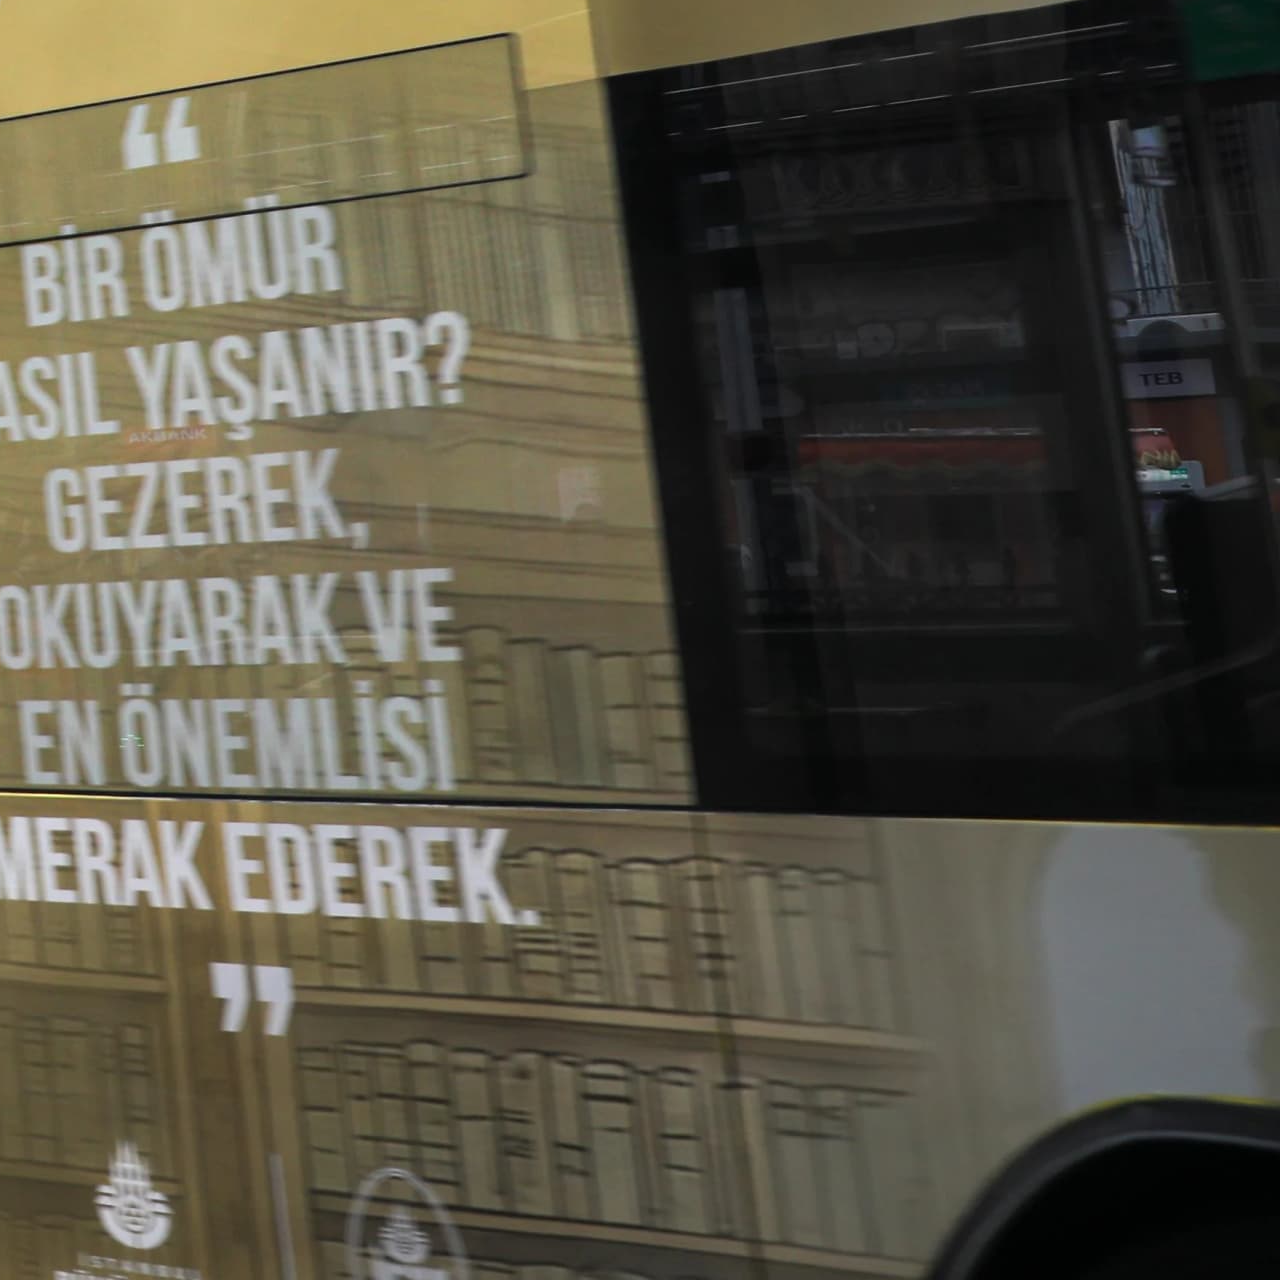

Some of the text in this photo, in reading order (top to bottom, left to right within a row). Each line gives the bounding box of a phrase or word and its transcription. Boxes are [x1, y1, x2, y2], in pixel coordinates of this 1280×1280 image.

[21, 194, 342, 328] BİR ÖMÜR
[126, 311, 471, 442] YAŞANIR?
[1140, 371, 1184, 387] TEB
[44, 448, 370, 554] GEZEREK,
[356, 567, 463, 663] VE
[18, 679, 457, 791] EN ÖNEMLİSİ
[221, 821, 541, 926] EDEREK.
